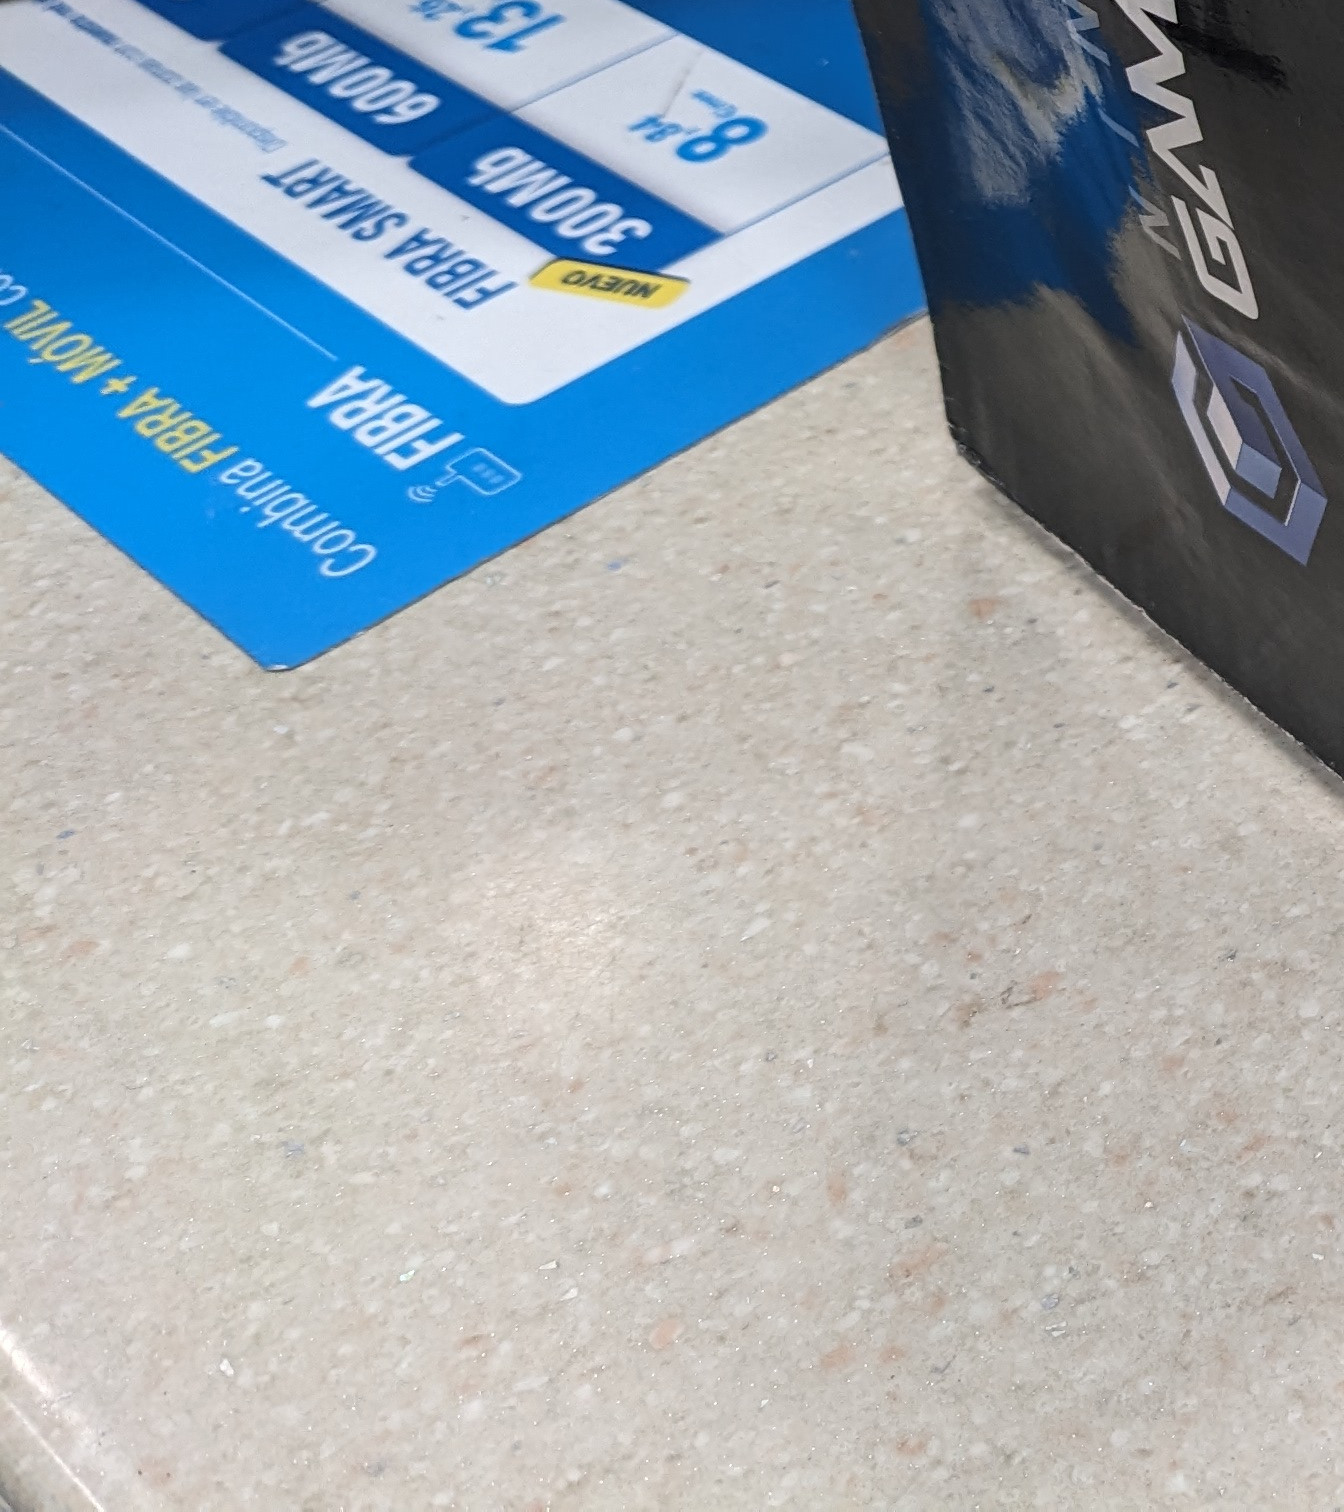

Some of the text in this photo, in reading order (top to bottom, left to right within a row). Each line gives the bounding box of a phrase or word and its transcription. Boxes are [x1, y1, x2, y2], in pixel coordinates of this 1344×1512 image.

[273, 29, 439, 125] 600Mb
[261, 157, 519, 310] FIBRA SMART
[467, 146, 653, 256] 300Mb
[560, 269, 662, 299] NUEVO
[2, 297, 123, 386] MÓVIL
[116, 387, 240, 474] FIBRA
[307, 366, 463, 471] FIBRA
[226, 457, 378, 578] Combina
